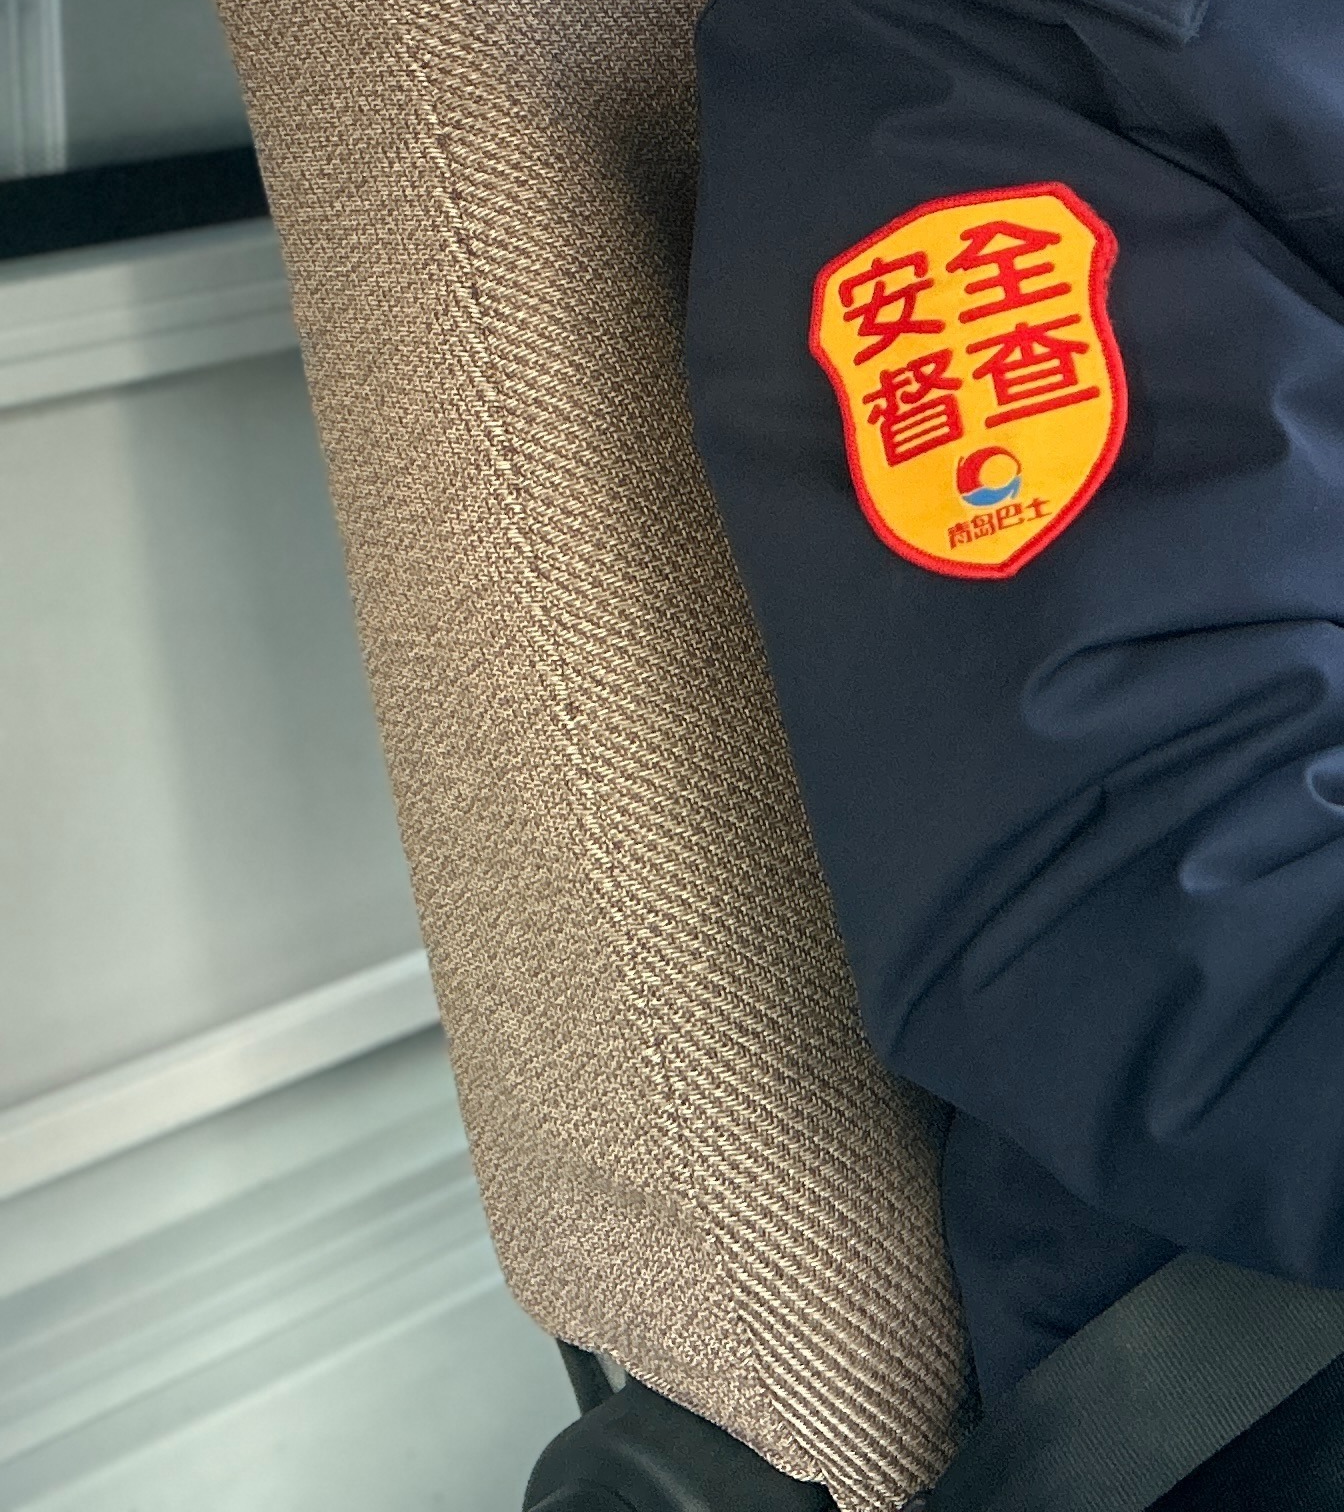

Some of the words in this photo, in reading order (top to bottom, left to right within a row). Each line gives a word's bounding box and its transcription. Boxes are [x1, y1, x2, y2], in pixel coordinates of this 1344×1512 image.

[838, 220, 1072, 366] 安全
[862, 314, 1100, 468] 督查
[947, 497, 1053, 550] 青岛巴士
